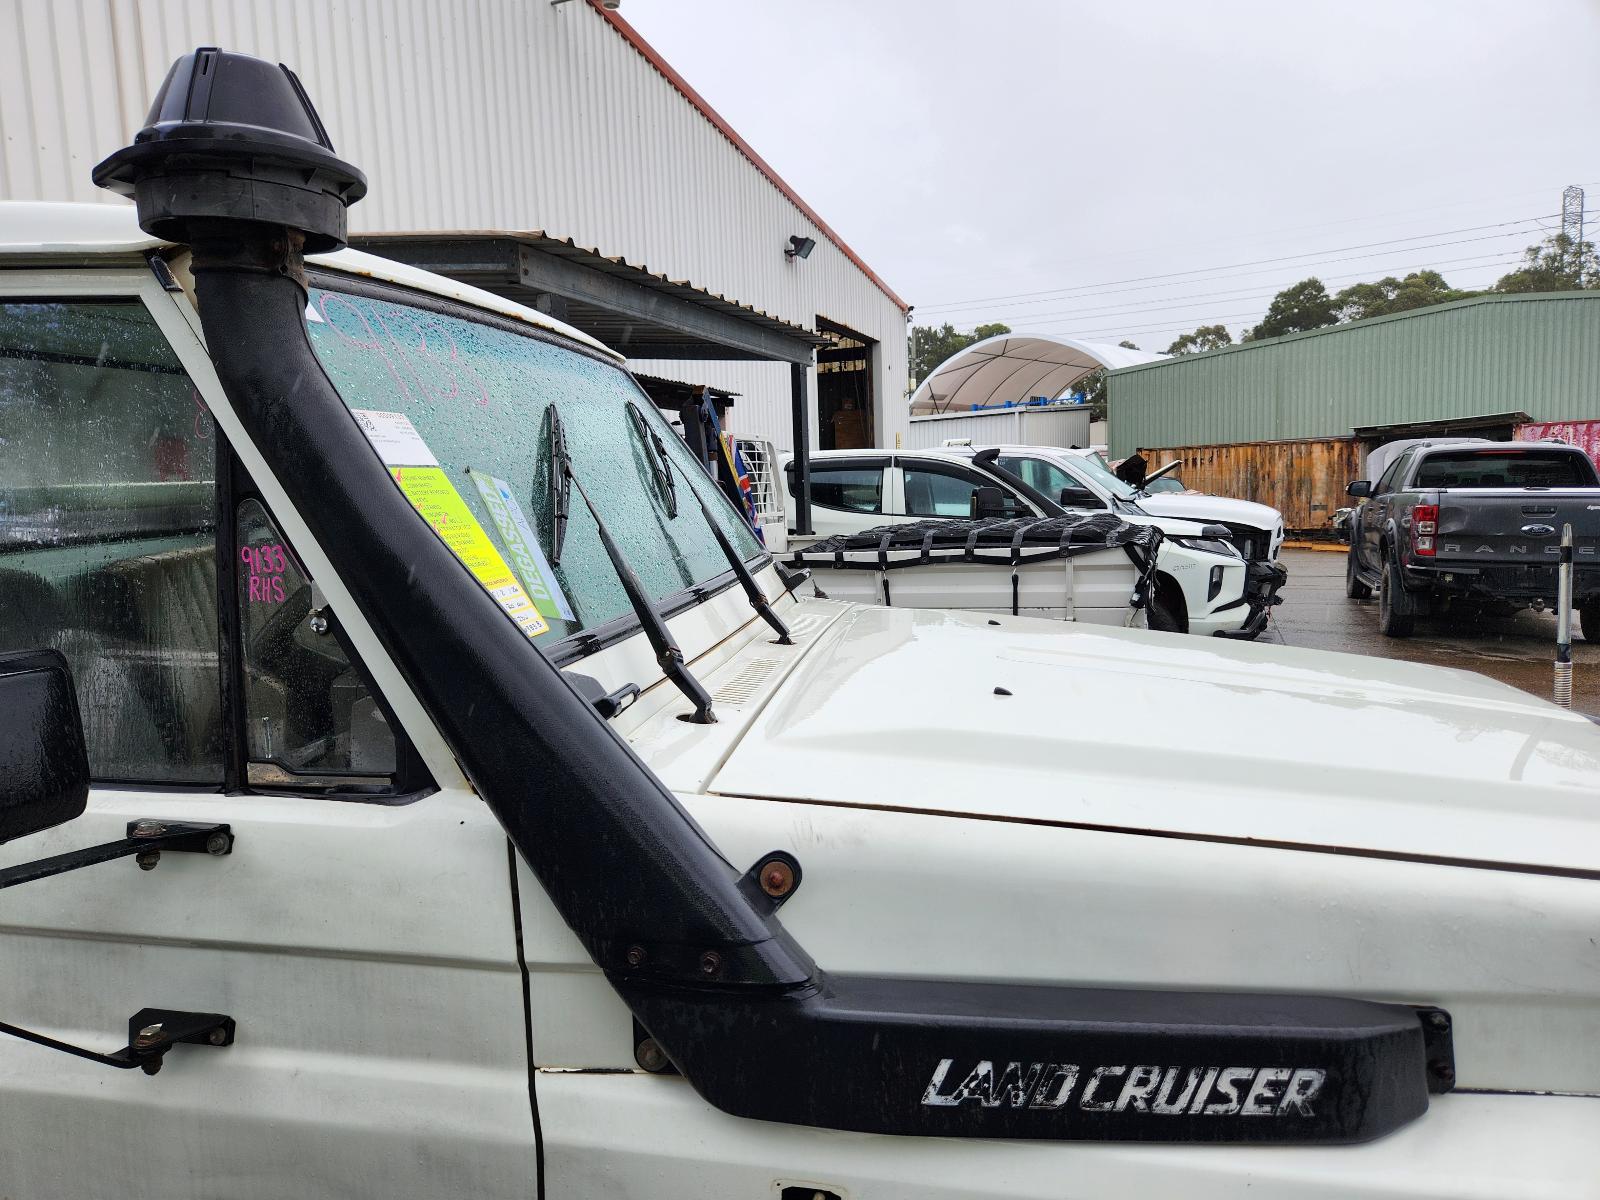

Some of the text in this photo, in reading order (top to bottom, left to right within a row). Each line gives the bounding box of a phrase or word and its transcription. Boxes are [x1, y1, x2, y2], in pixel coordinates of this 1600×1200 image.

[241, 544, 286, 576] 9133
[485, 488, 550, 600] DEGASSED
[249, 575, 286, 603] RHS
[921, 1058, 1328, 1116] LAND CRUISER
